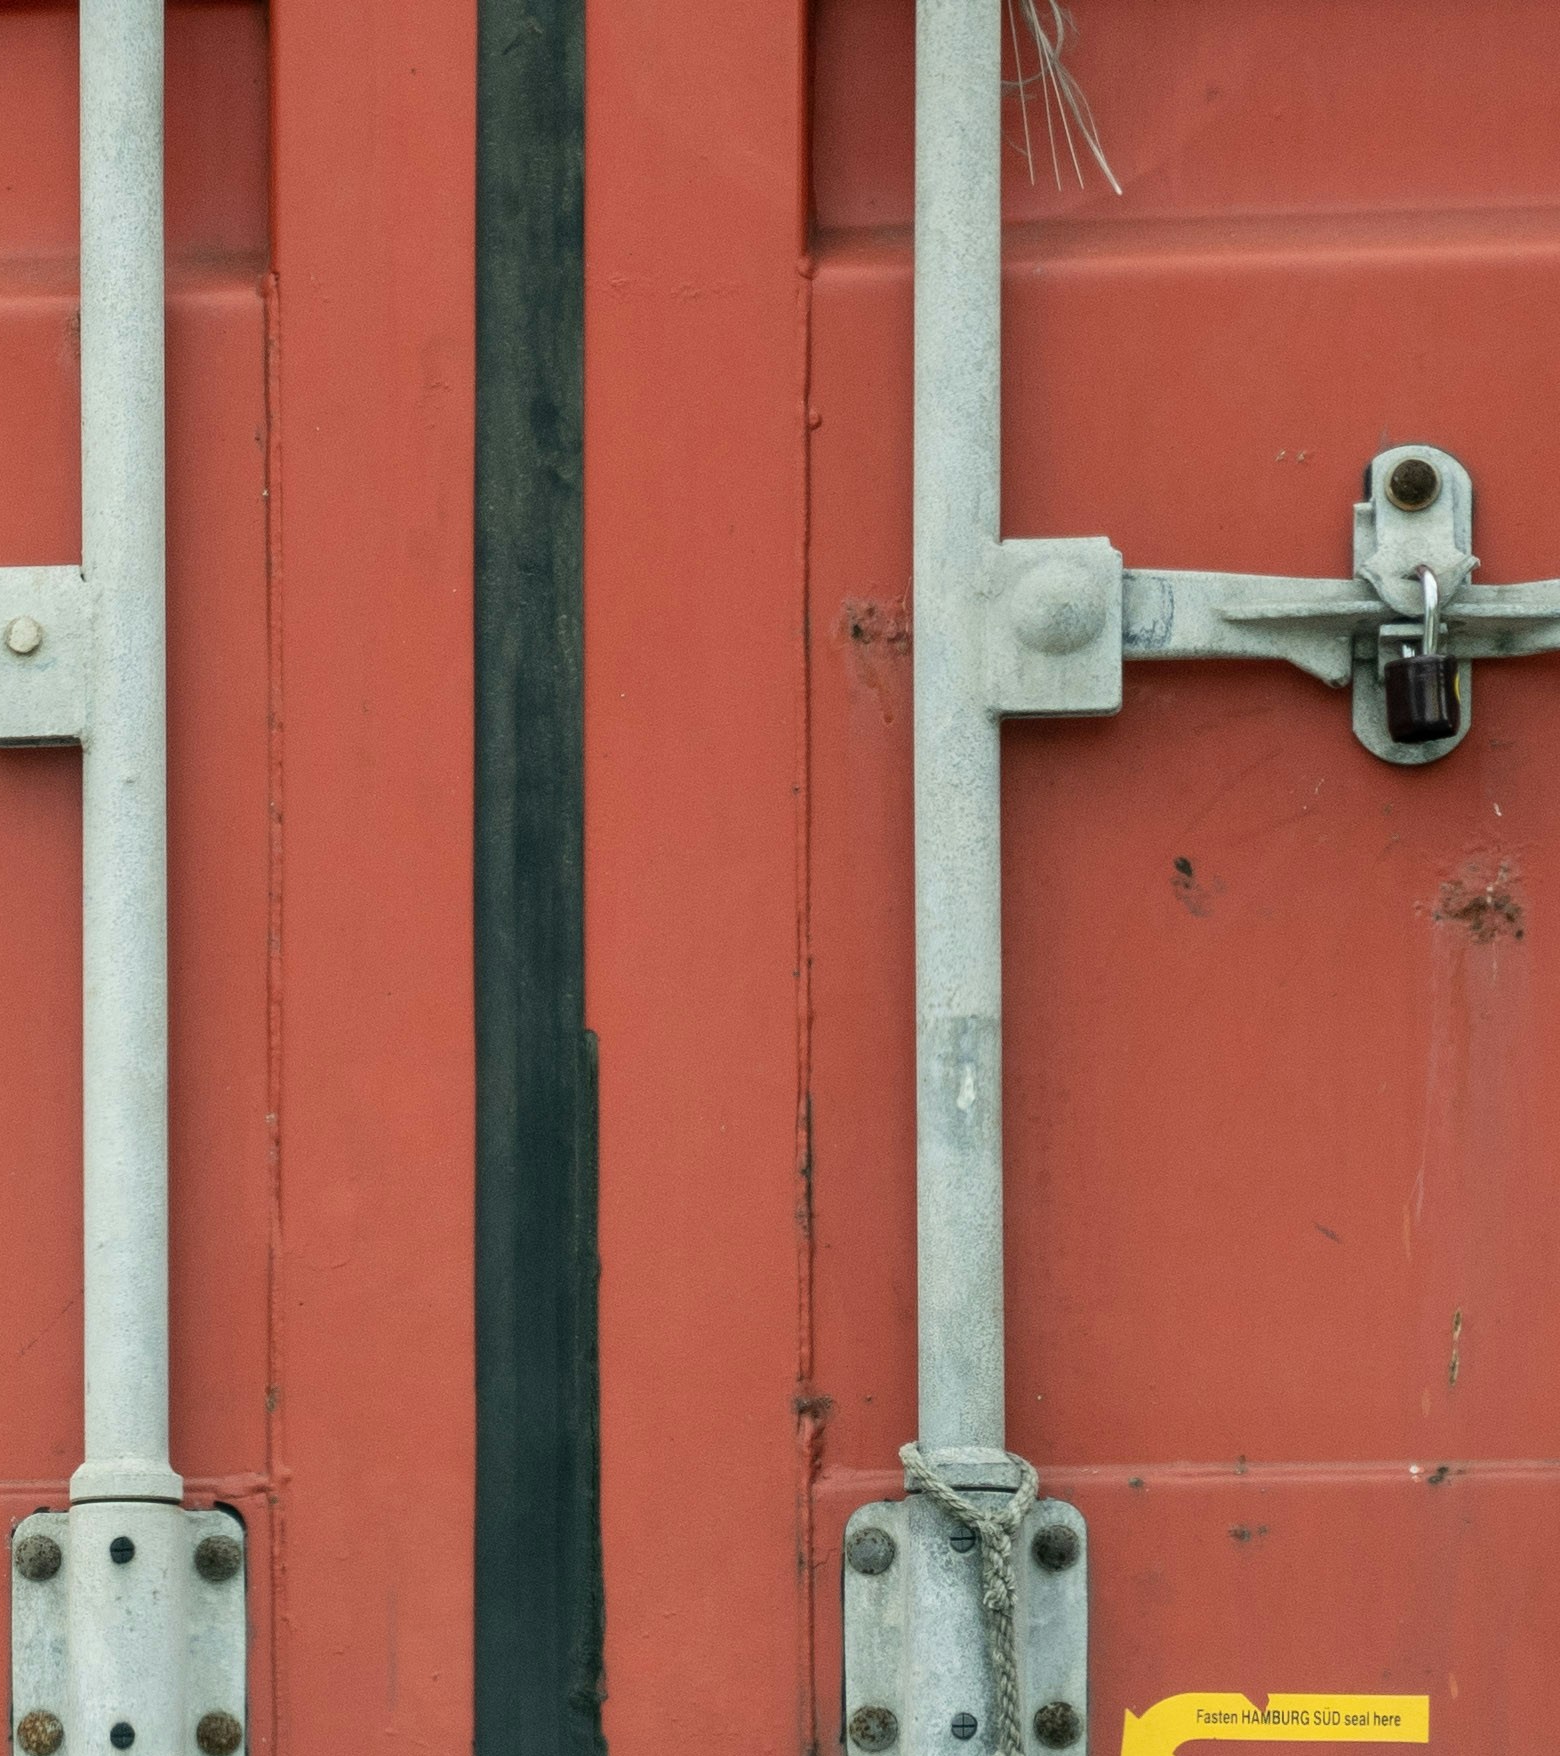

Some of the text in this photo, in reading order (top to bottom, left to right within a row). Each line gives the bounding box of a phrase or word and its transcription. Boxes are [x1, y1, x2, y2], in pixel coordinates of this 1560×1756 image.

[1197, 1706, 1401, 1727] Fasten HAMBURG SÜD seal here
